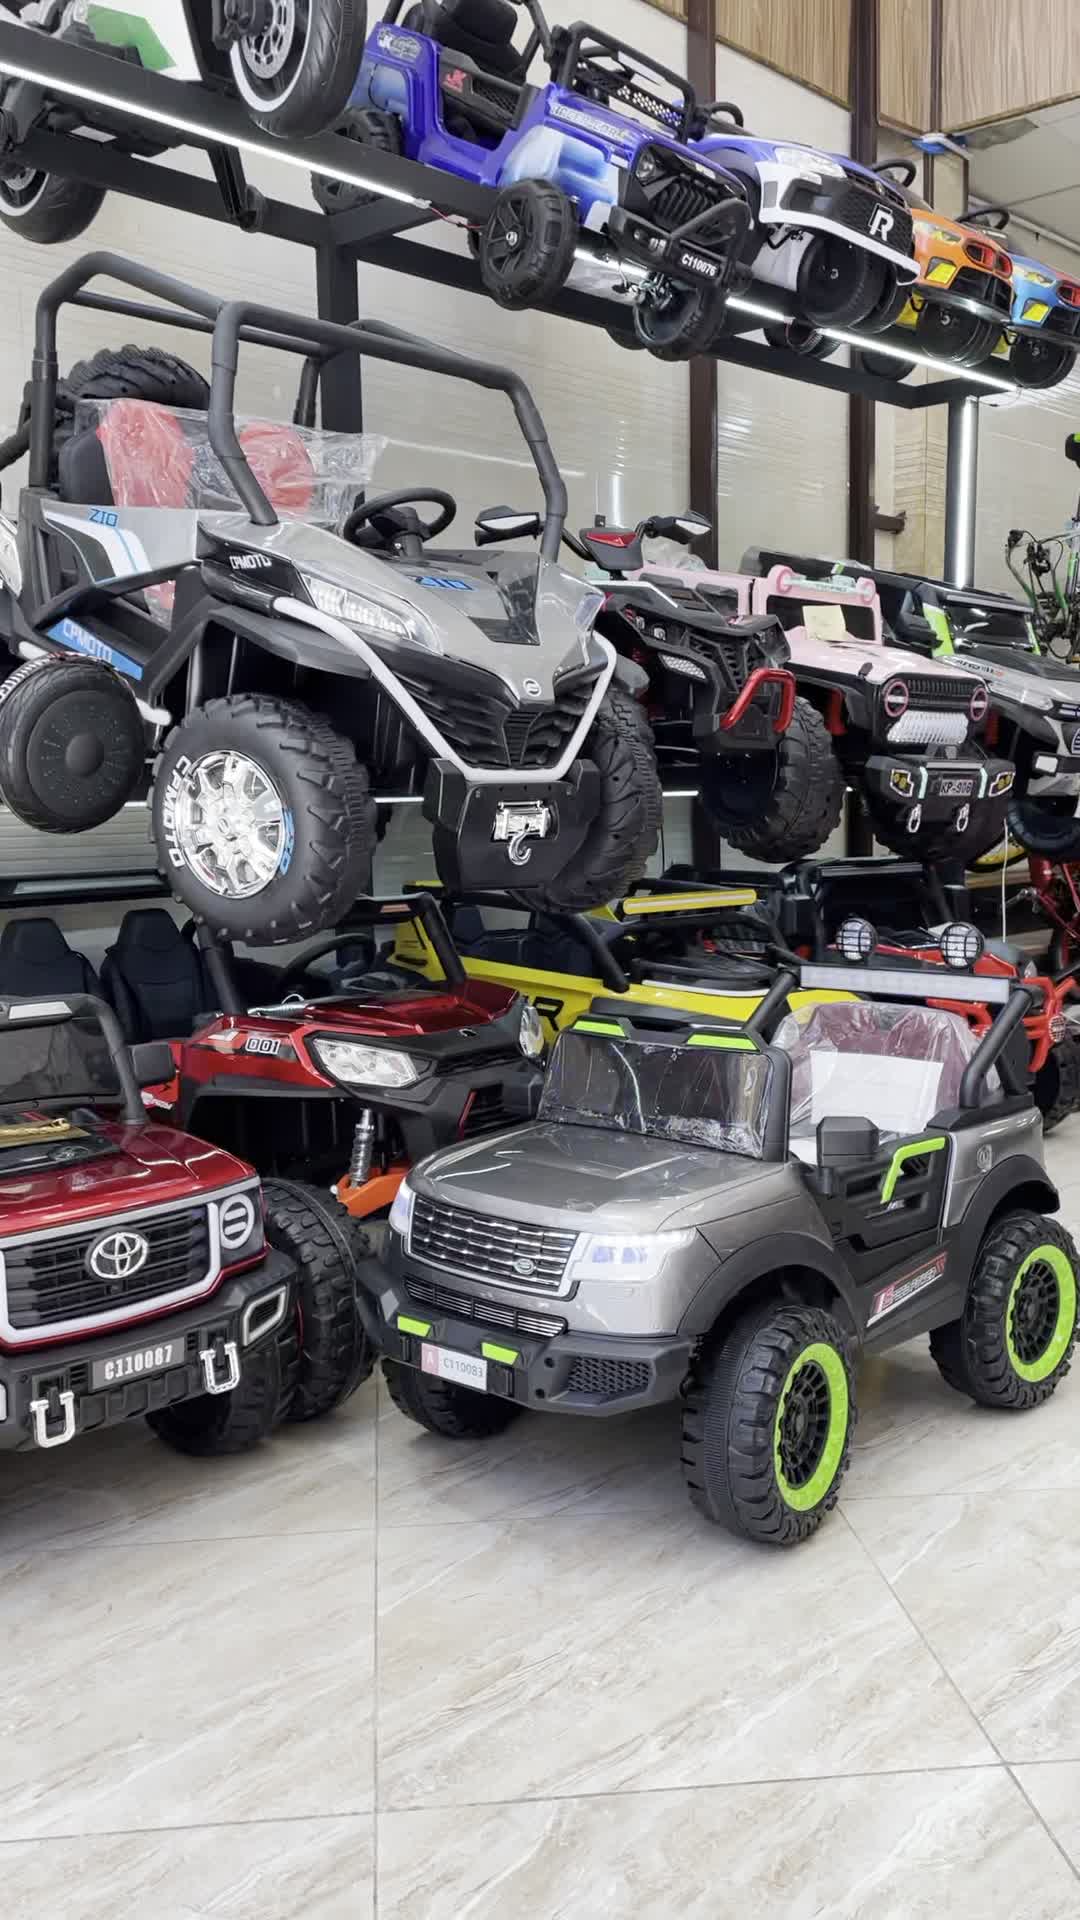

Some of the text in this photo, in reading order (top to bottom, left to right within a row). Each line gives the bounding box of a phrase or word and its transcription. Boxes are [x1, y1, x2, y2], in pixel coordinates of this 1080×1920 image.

[868, 203, 894, 241] R
[681, 253, 717, 277] C110076
[245, 1038, 281, 1056] 001
[105, 1344, 173, 1381] C110087
